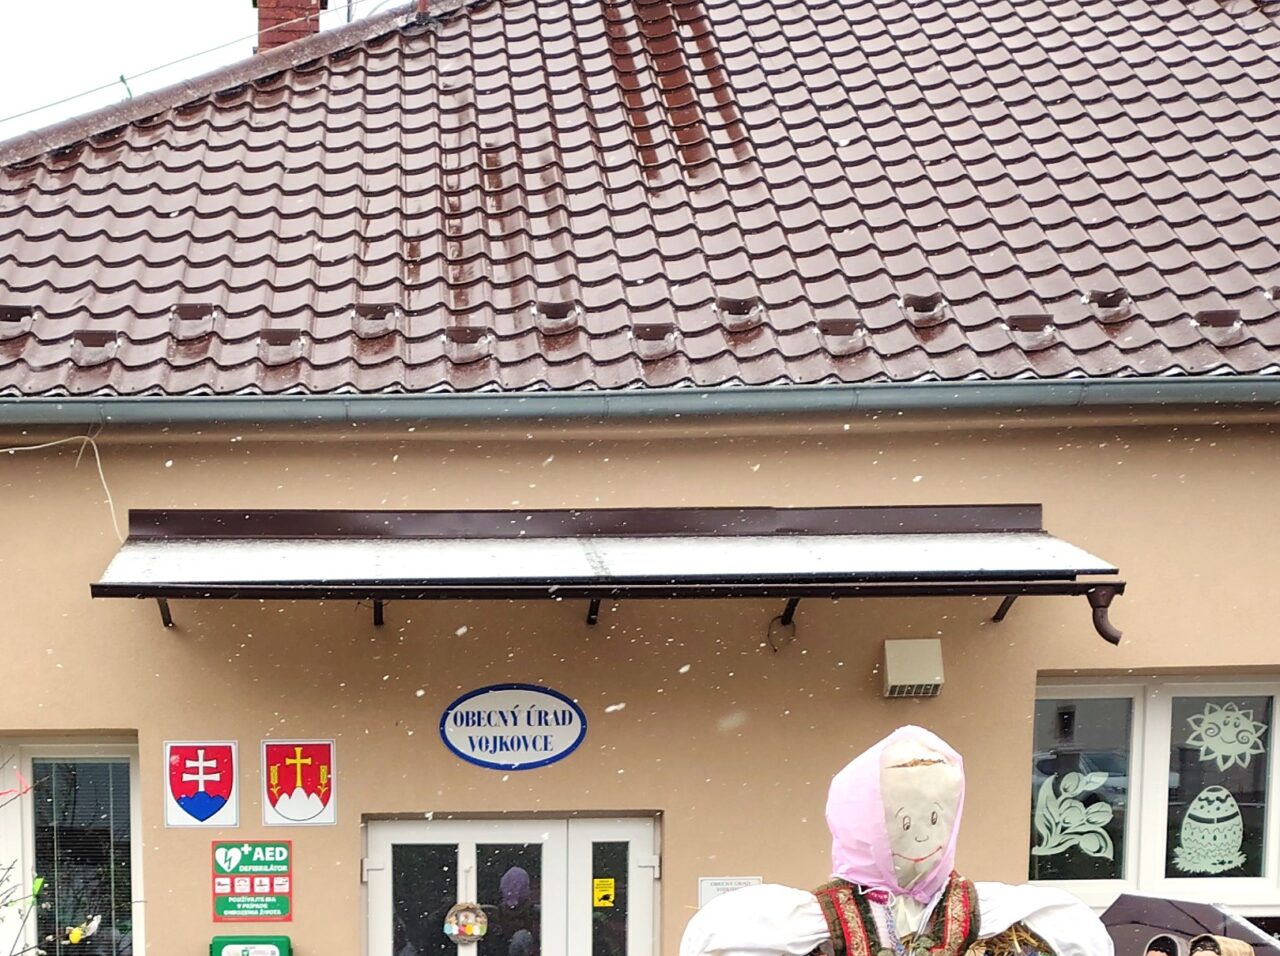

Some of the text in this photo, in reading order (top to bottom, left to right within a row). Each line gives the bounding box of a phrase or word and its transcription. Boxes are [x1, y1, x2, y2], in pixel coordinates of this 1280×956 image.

[453, 703, 573, 728] OBECNÝ ÚRAD
[468, 734, 554, 754] VOJKOVCE
[252, 846, 288, 862] AED
